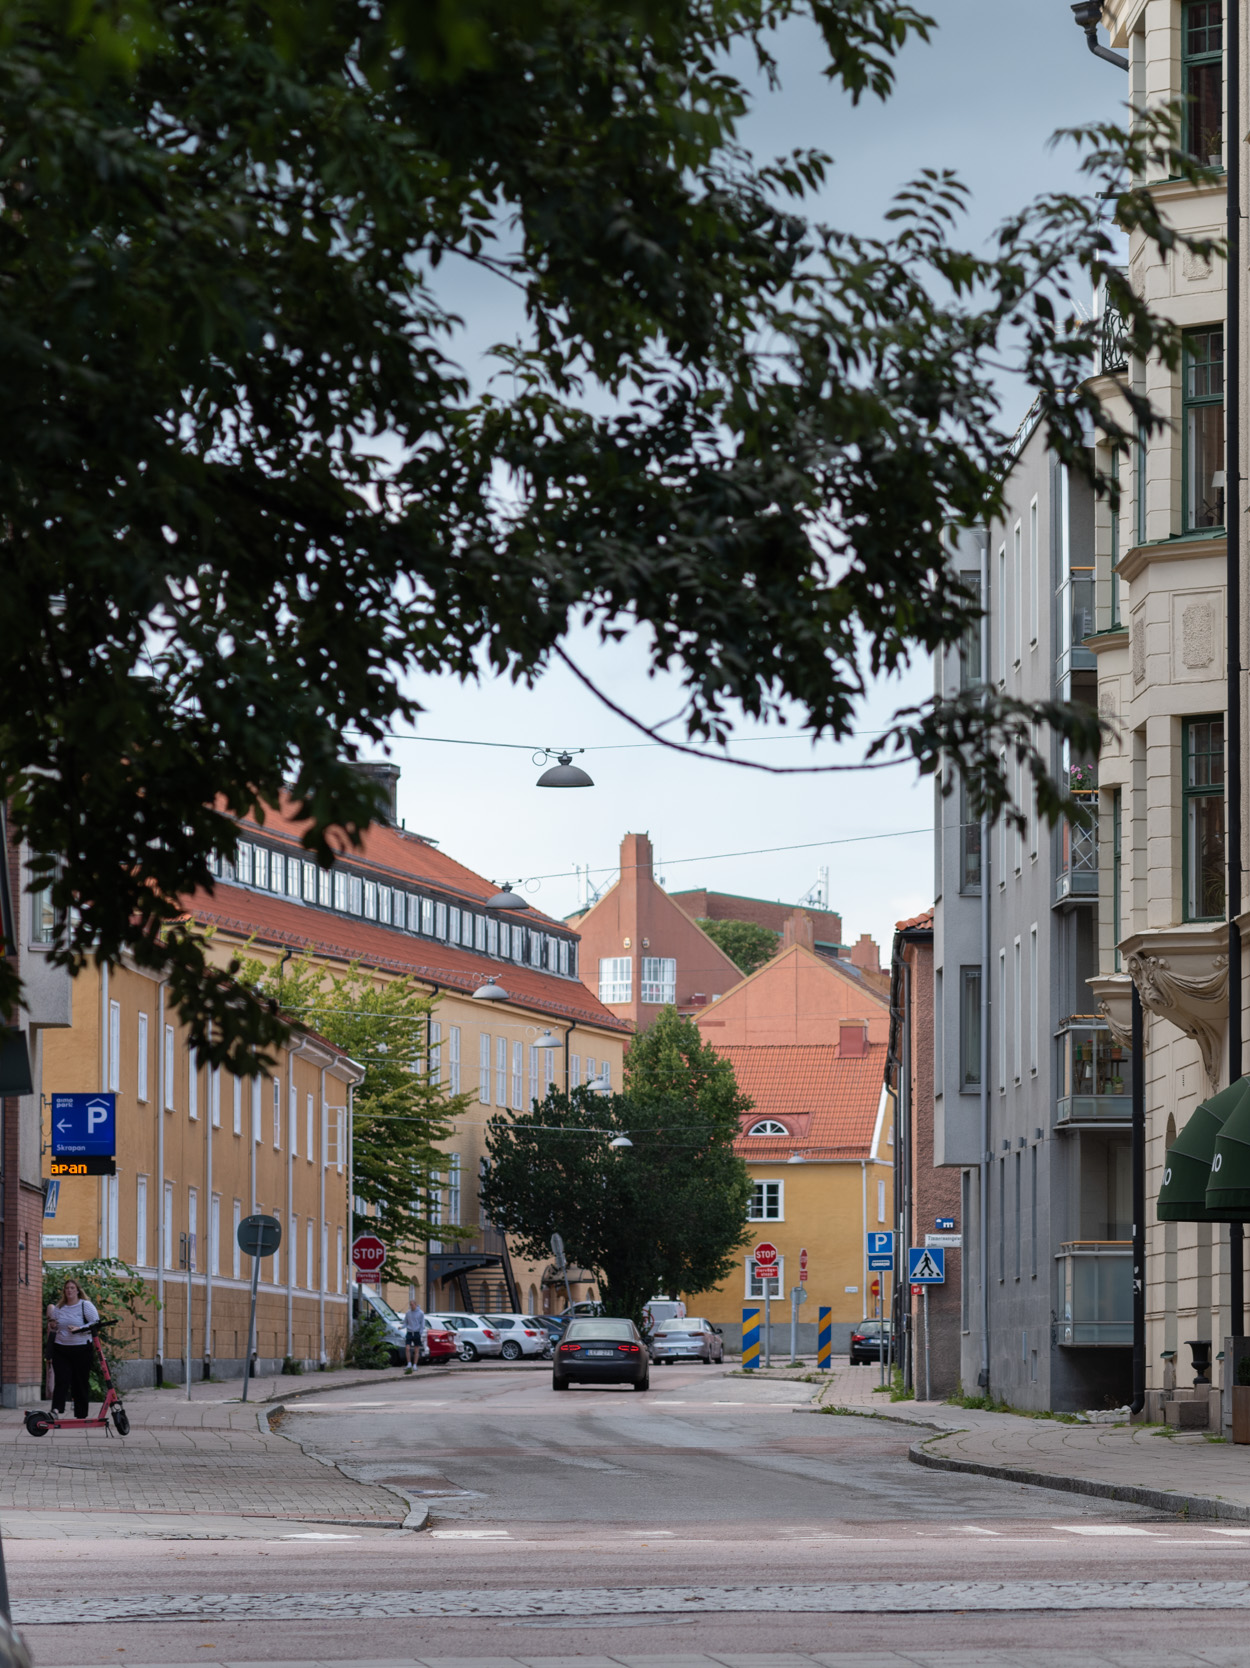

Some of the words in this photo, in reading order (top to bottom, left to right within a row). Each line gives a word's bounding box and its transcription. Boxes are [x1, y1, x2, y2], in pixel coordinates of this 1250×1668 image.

[87, 1106, 108, 1134] P
[56, 1144, 86, 1152] Skrapan
[875, 1234, 888, 1252] P
[353, 1248, 383, 1260] STOP
[756, 1250, 776, 1259] STOP
